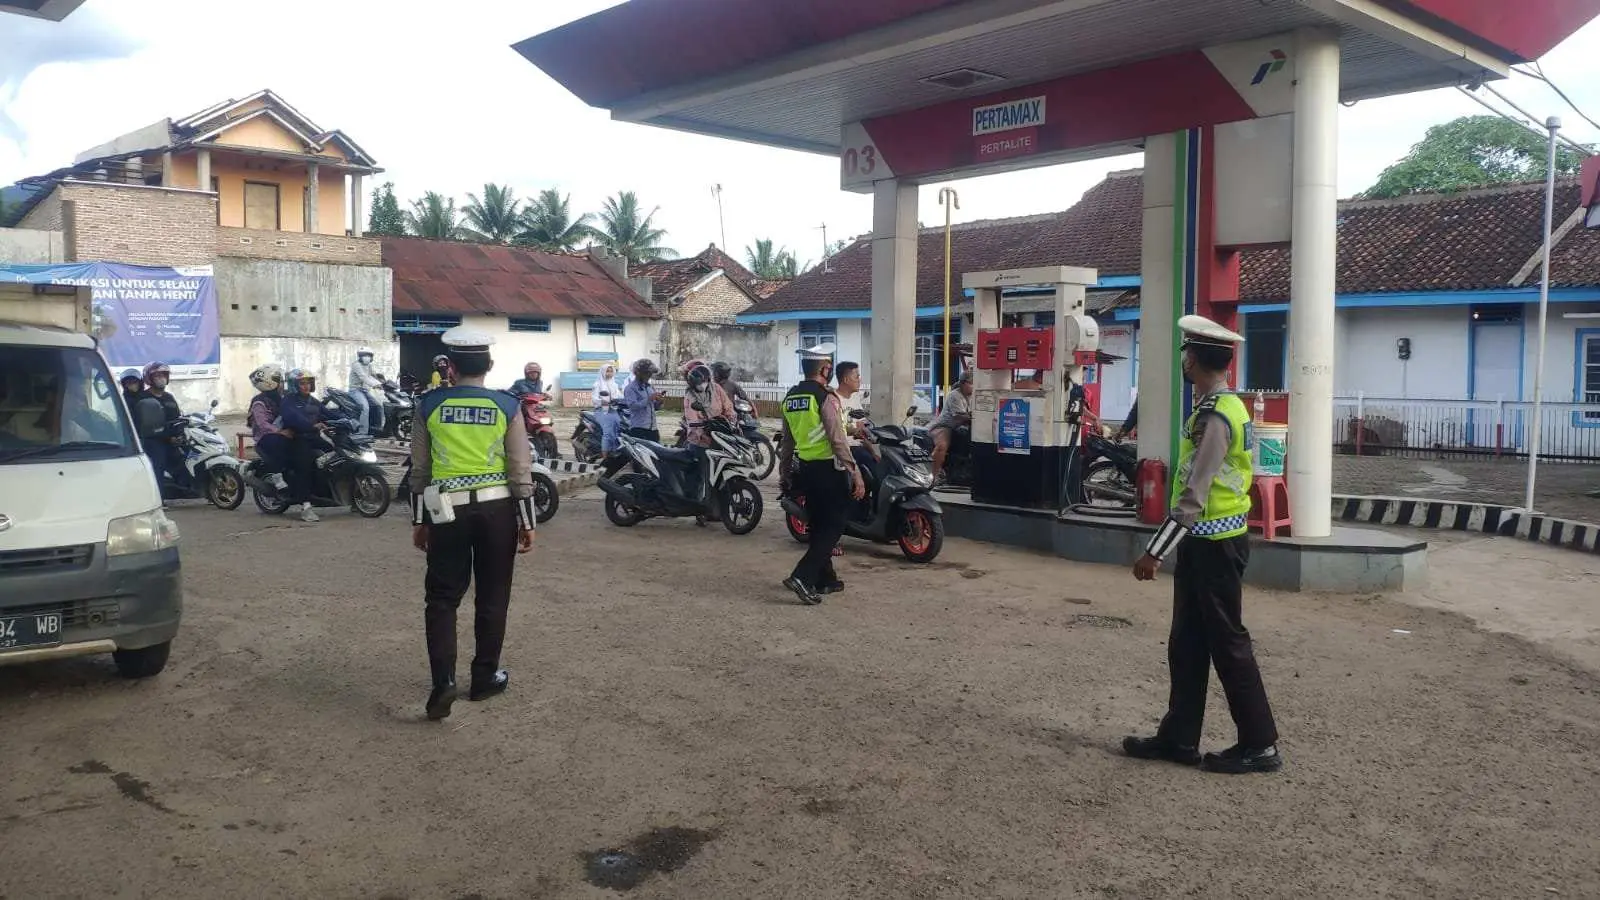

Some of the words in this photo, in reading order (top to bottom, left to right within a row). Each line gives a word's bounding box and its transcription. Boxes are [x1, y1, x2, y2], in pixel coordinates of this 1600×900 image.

[975, 100, 1040, 131] PERTAMAX
[980, 135, 1032, 154] PERTALITE
[843, 145, 875, 175] 03
[112, 279, 157, 289] UNTUK
[159, 279, 199, 289] SELALU
[93, 289, 117, 299] ANI
[118, 290, 160, 299] TANPA
[162, 290, 197, 300] HENTI
[442, 406, 496, 424] POLISI
[36, 616, 58, 634] WB
